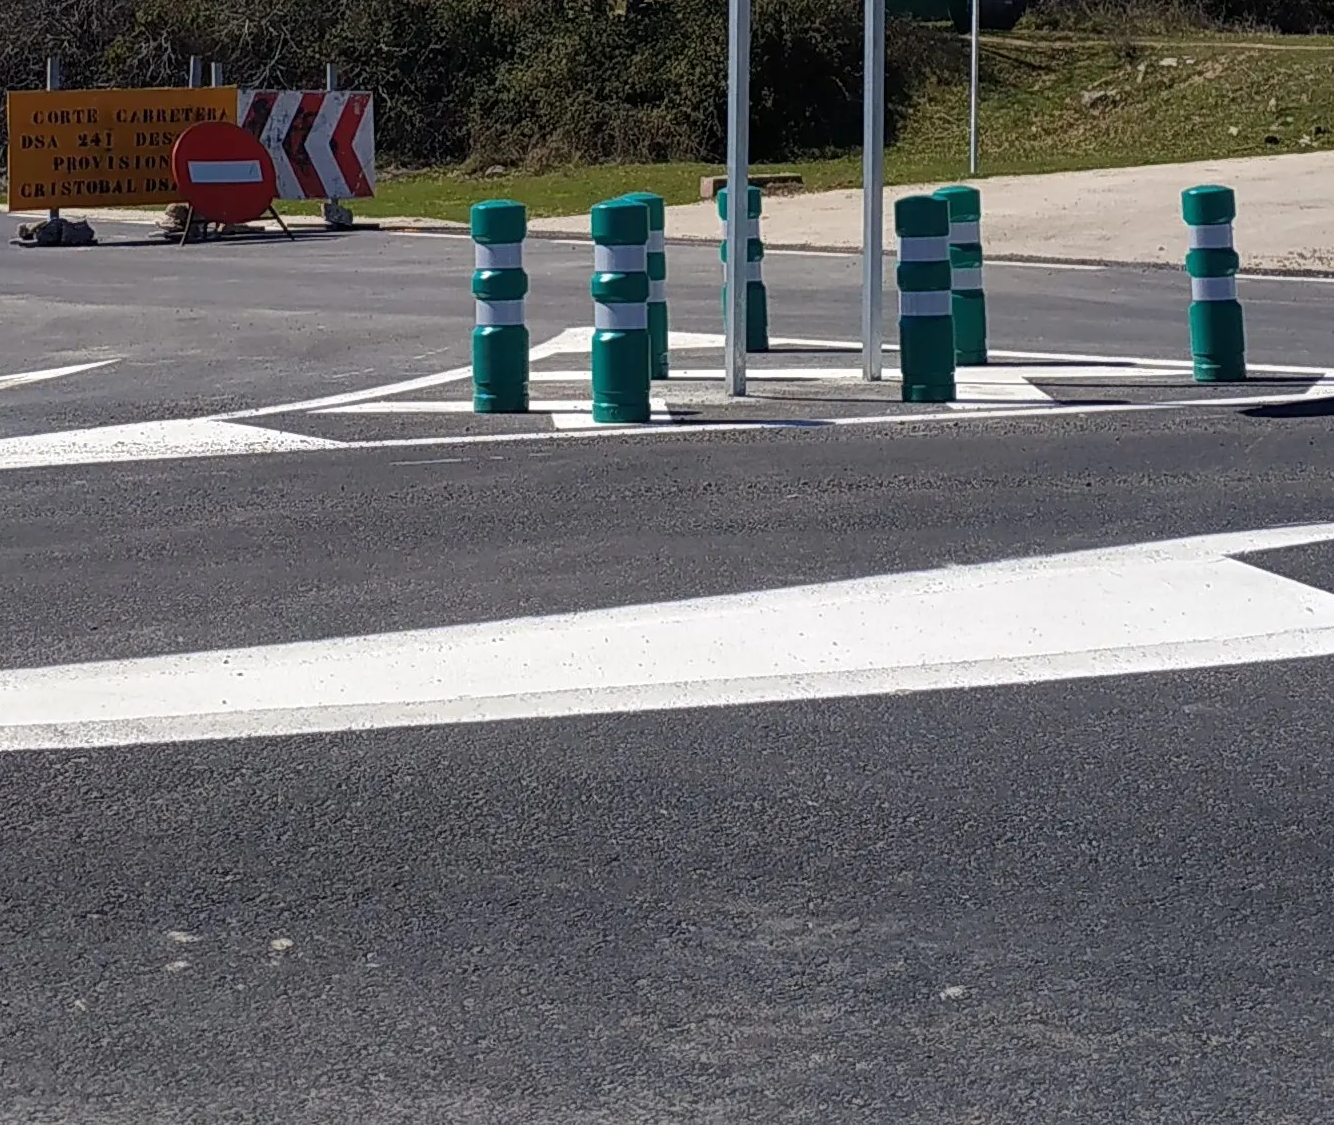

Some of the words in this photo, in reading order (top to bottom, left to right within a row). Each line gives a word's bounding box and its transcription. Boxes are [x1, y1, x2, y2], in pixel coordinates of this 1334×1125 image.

[32, 108, 97, 124] CORTE
[117, 106, 227, 123] CARRETERA
[21, 134, 58, 149] DSA
[136, 131, 180, 147] DES
[53, 154, 170, 173] PROVISION
[20, 179, 137, 197] CRISTOBAL
